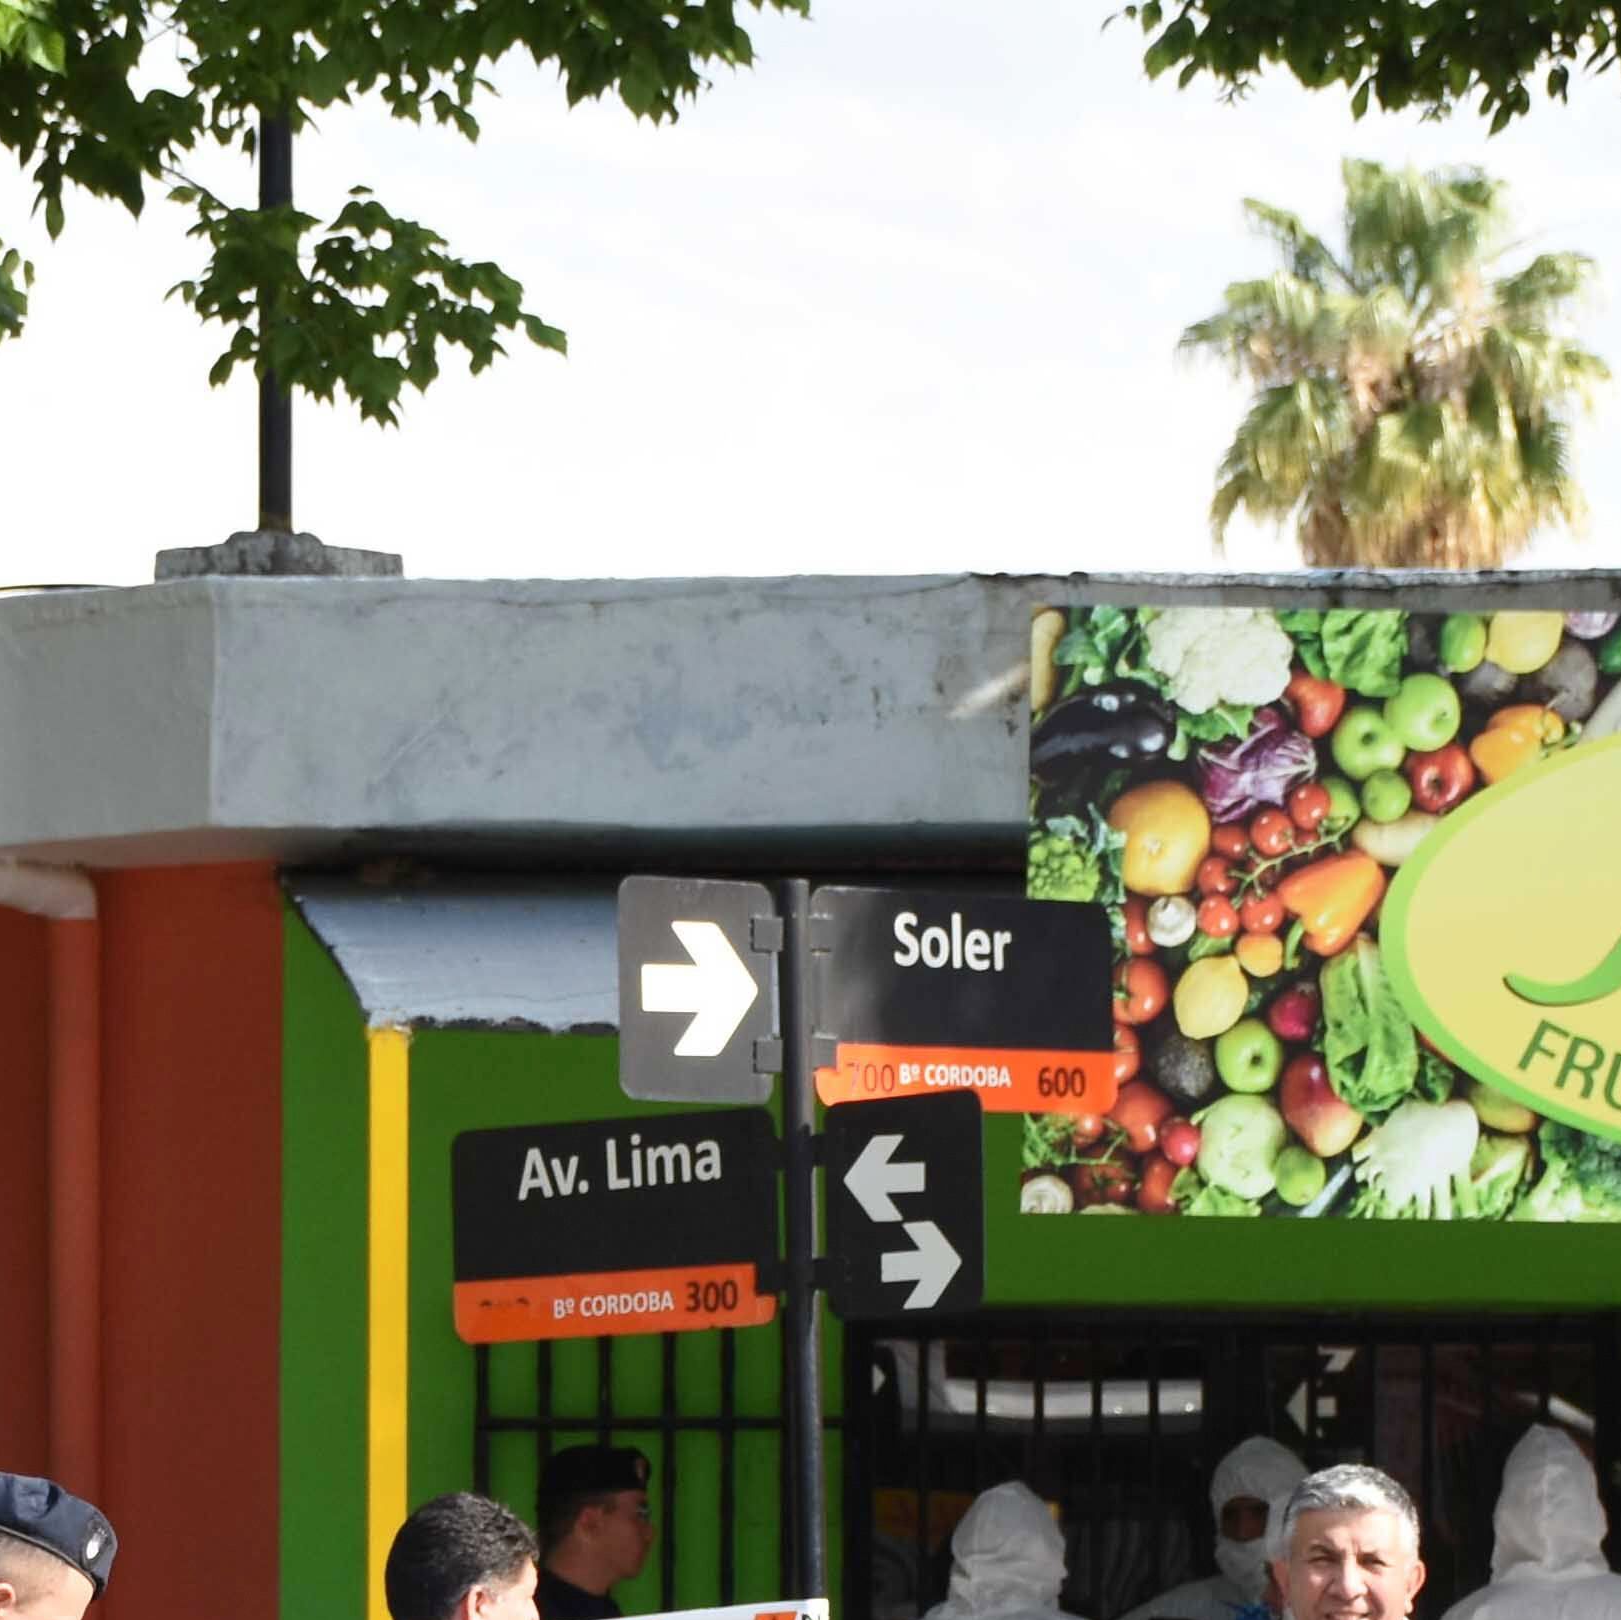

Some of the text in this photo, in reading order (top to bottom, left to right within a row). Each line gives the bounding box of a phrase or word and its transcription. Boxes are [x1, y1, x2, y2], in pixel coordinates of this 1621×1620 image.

[893, 911, 1012, 972] Soler
[924, 1063, 1013, 1088] CORDOBA
[1037, 1066, 1087, 1098] 600
[517, 1133, 722, 1202] Av. Lima
[579, 1290, 675, 1318] CORDOBA
[684, 1279, 739, 1314] 300
